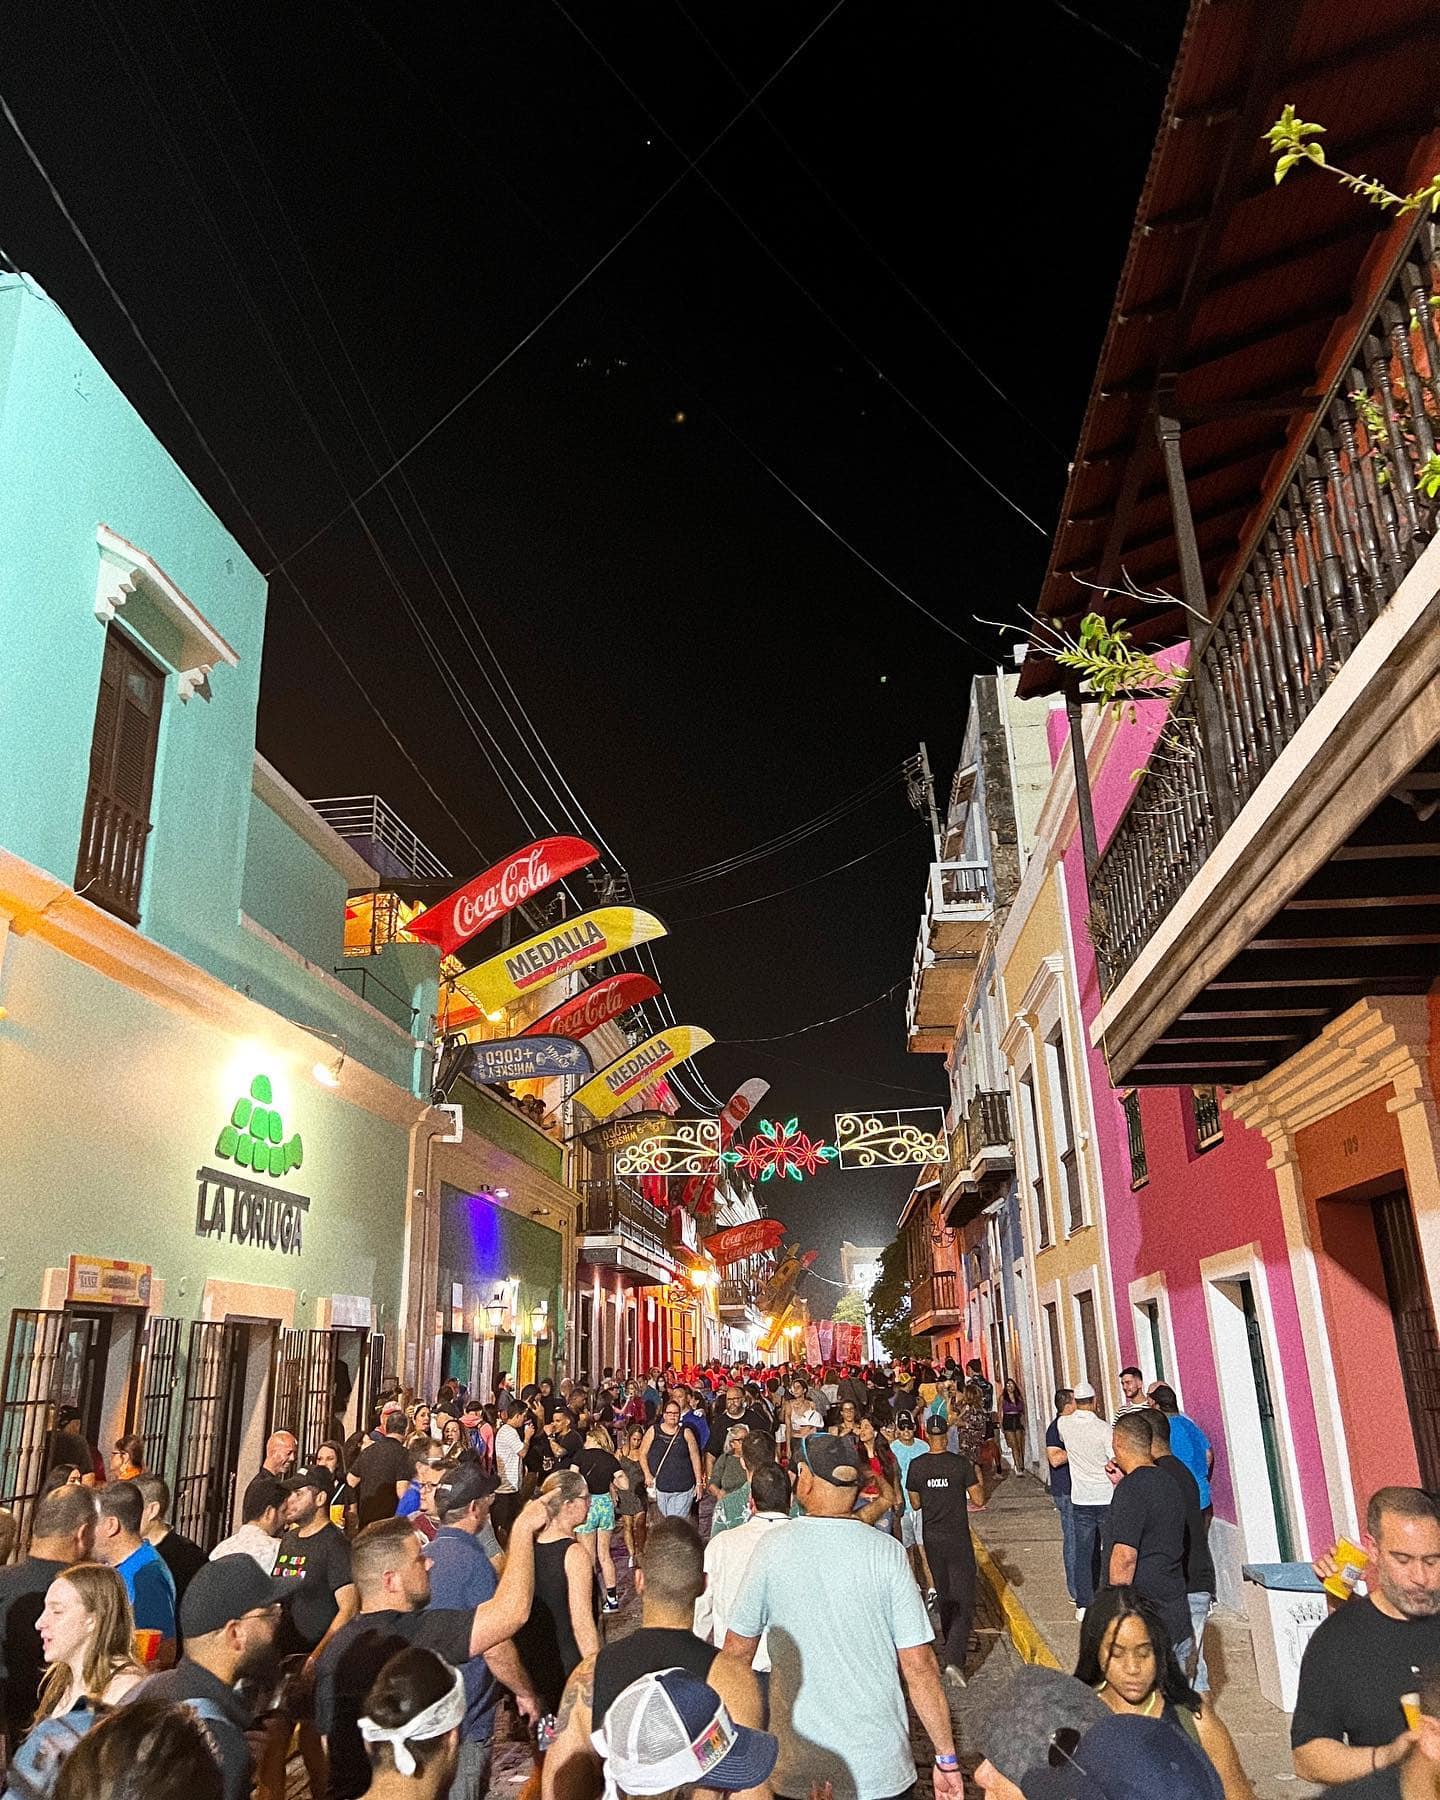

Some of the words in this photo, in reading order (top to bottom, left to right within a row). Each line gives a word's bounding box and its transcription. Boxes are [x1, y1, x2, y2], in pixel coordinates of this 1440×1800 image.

[504, 920, 606, 981] MEDALLA
[488, 1062, 535, 1078] WHISKEY
[605, 1039, 672, 1091] MEDALLA
[195, 1180, 226, 1240] LA
